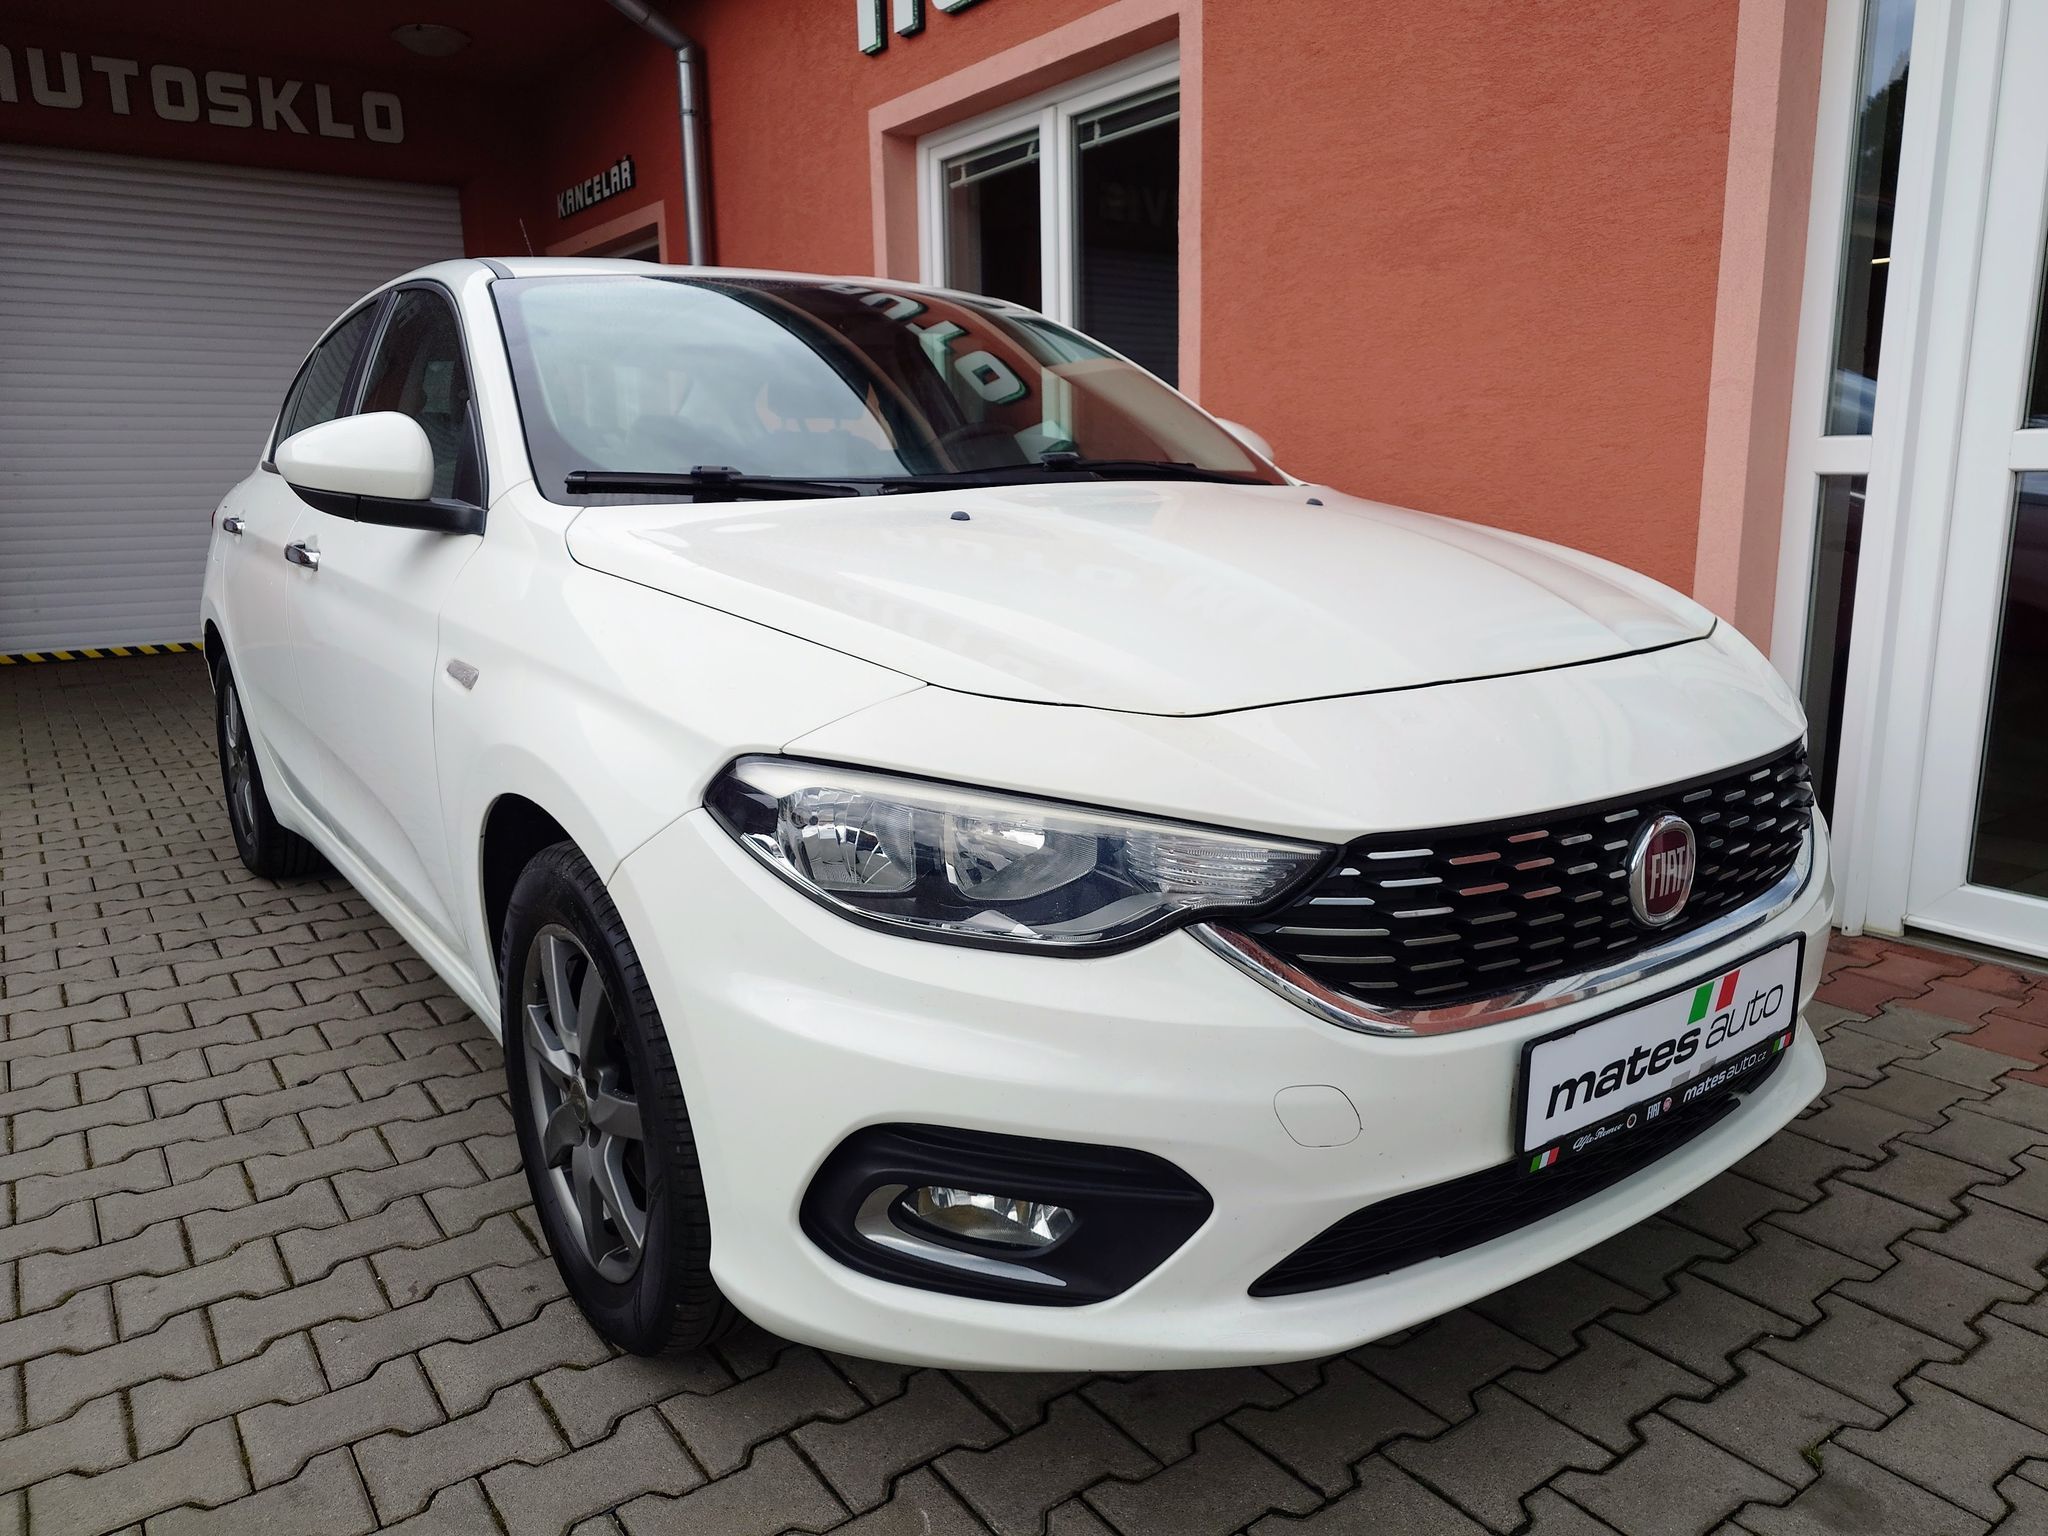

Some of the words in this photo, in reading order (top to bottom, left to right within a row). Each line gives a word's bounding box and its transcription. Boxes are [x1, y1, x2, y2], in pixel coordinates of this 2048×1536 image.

[1649, 845, 1686, 900] FIAT
[1545, 1028, 1702, 1120] mates
[1705, 984, 1784, 1050] auto
[1646, 1101, 1662, 1121] FIAT
[1683, 1050, 1768, 1103] matesauto.cz
